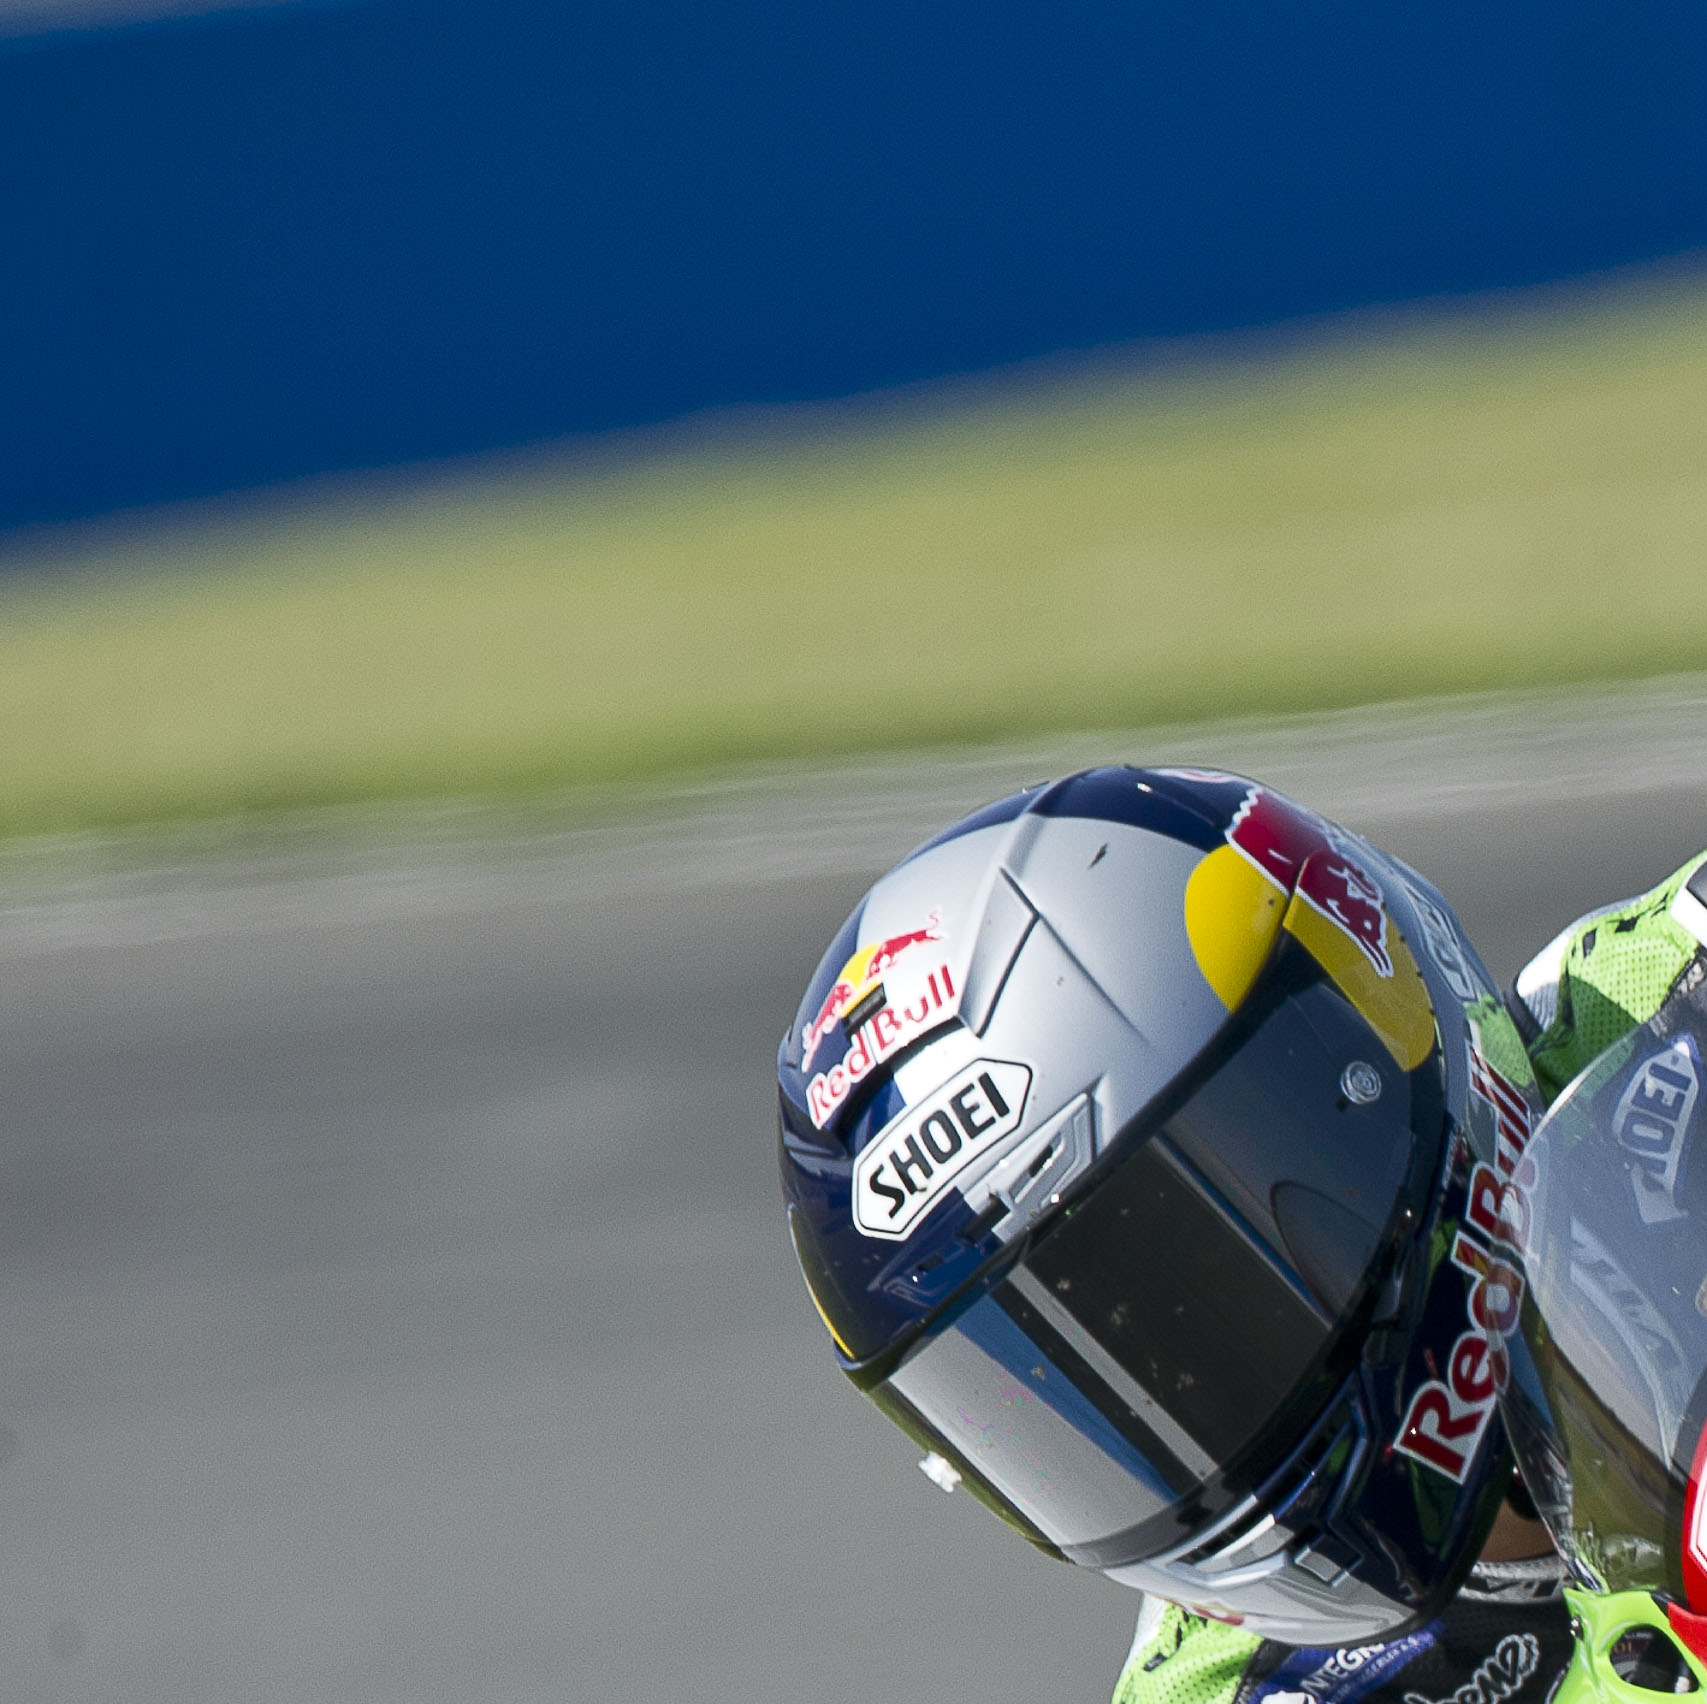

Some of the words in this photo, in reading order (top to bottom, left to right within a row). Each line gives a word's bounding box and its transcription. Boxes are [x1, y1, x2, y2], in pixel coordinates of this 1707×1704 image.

[806, 1026, 876, 1127] Red
[873, 964, 956, 1056] Bull
[869, 1072, 1011, 1219] SHOEI
[1394, 1228, 1526, 1487] Red
[1464, 1036, 1545, 1264] Bull
